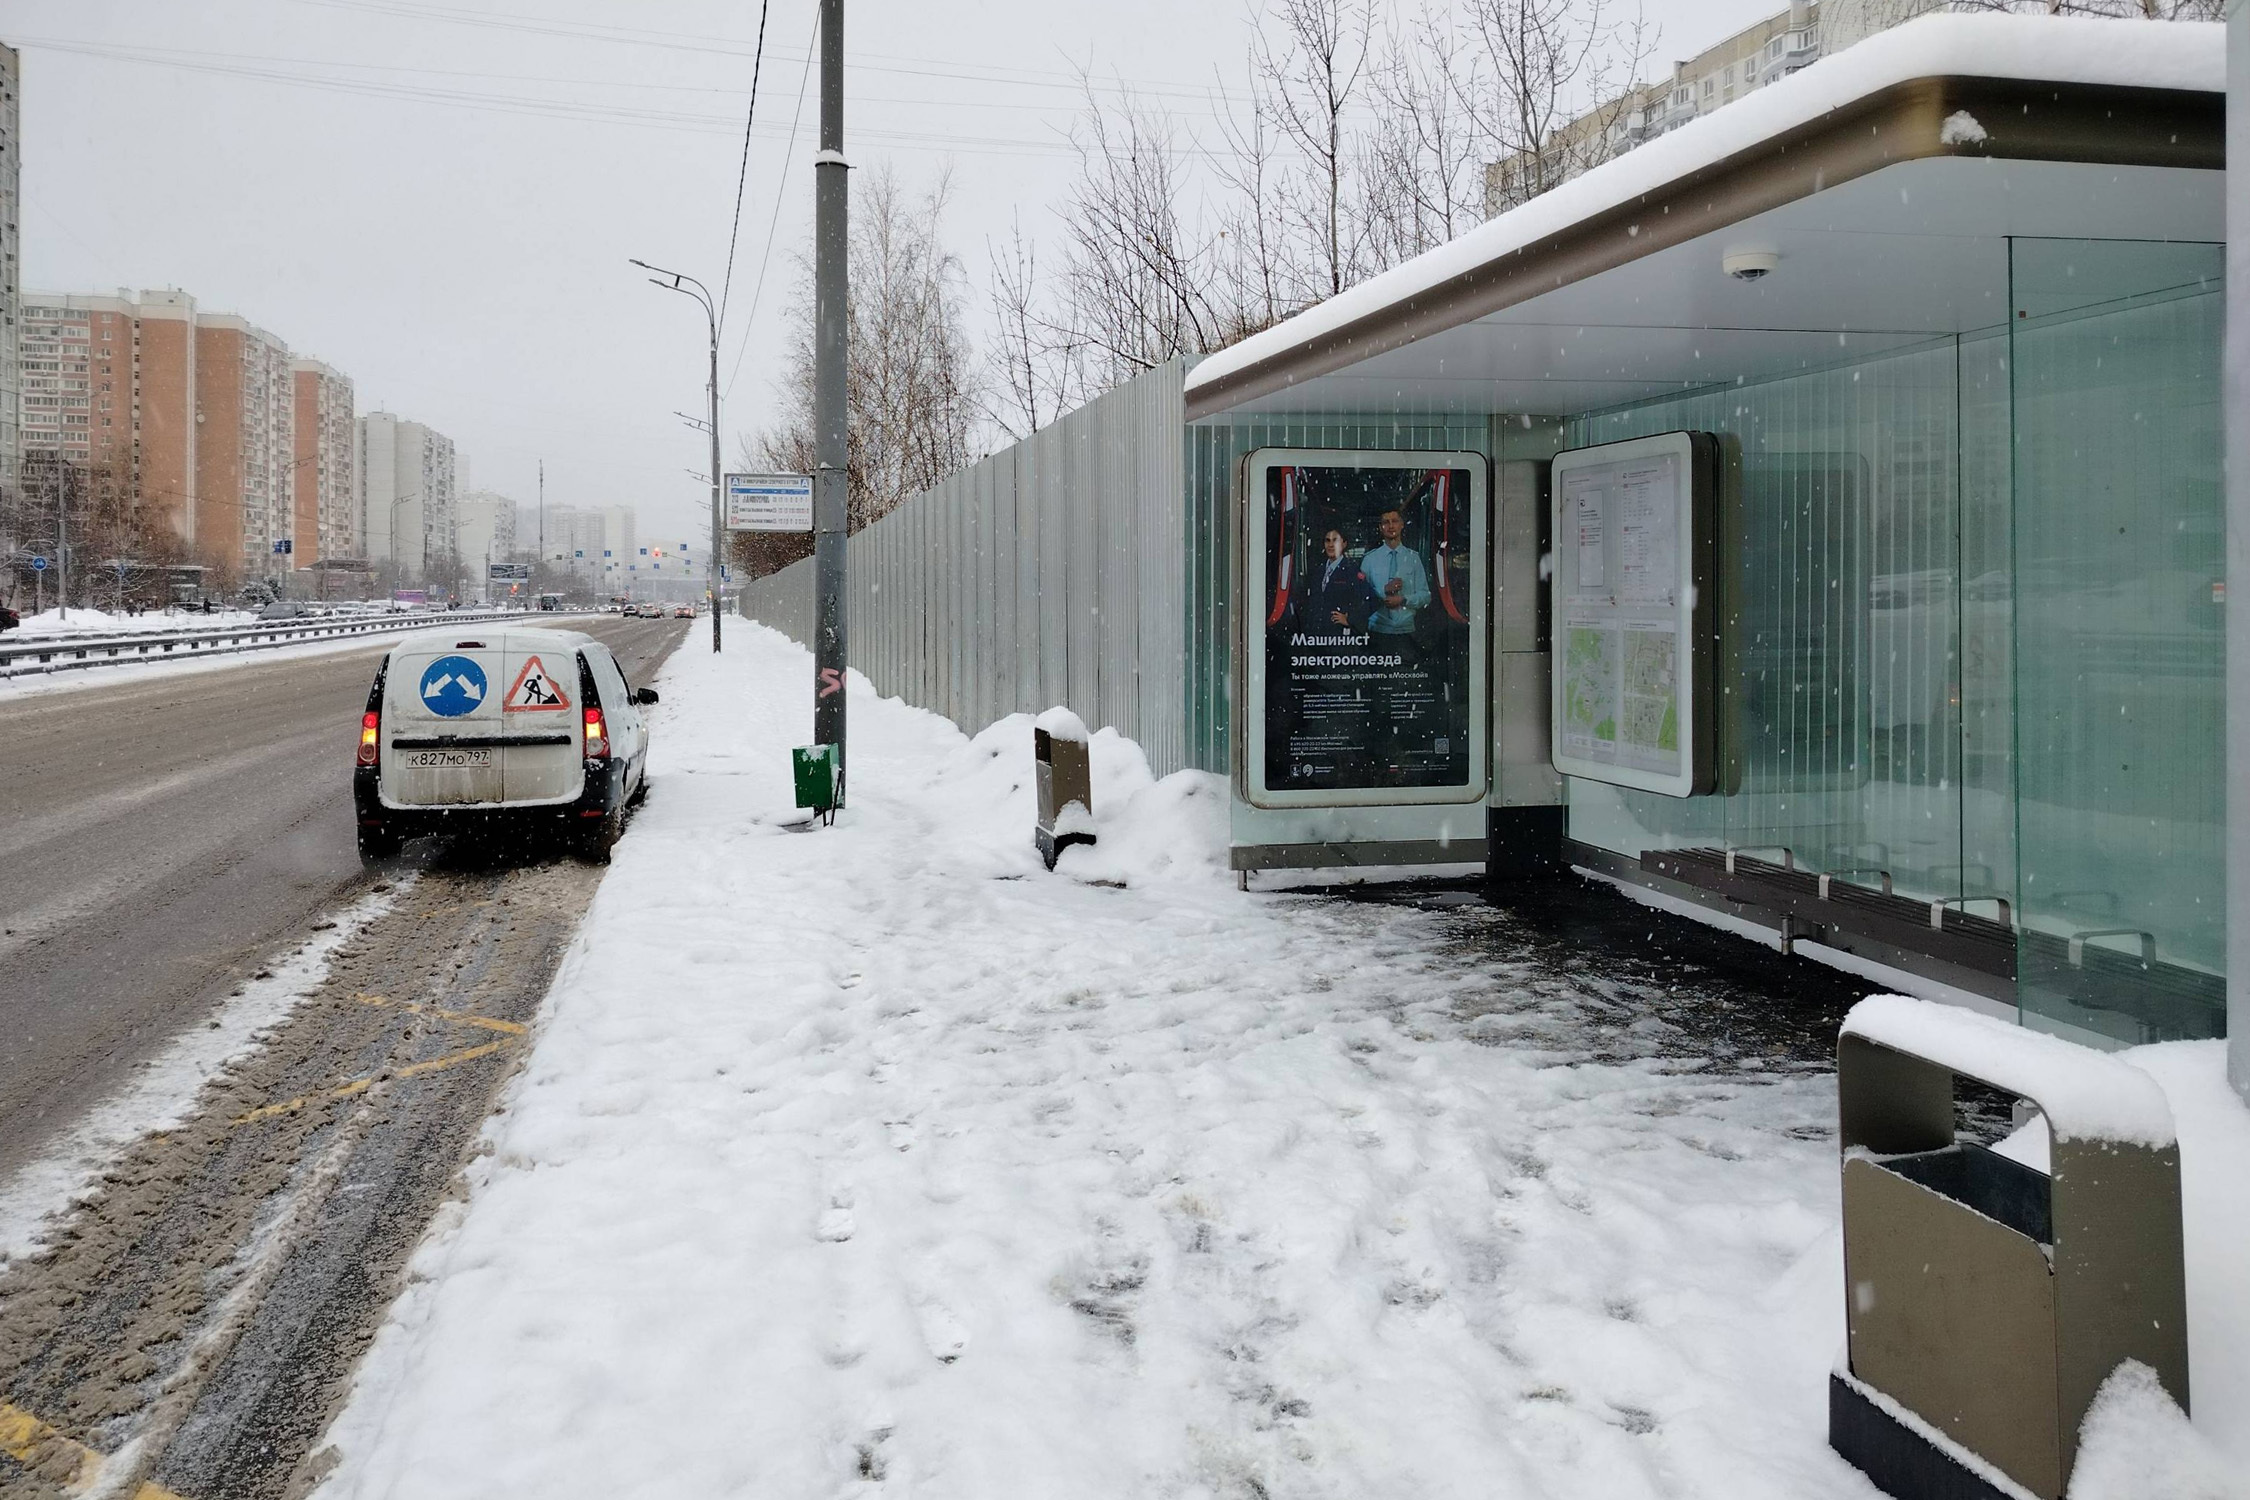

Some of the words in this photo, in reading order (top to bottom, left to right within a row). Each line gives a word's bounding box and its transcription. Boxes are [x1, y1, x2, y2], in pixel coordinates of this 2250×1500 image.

[1290, 632, 1371, 646] Машинист
[1290, 654, 1402, 668] электропоезда
[1352, 672, 1388, 682] управлять
[467, 751, 488, 762] 797
